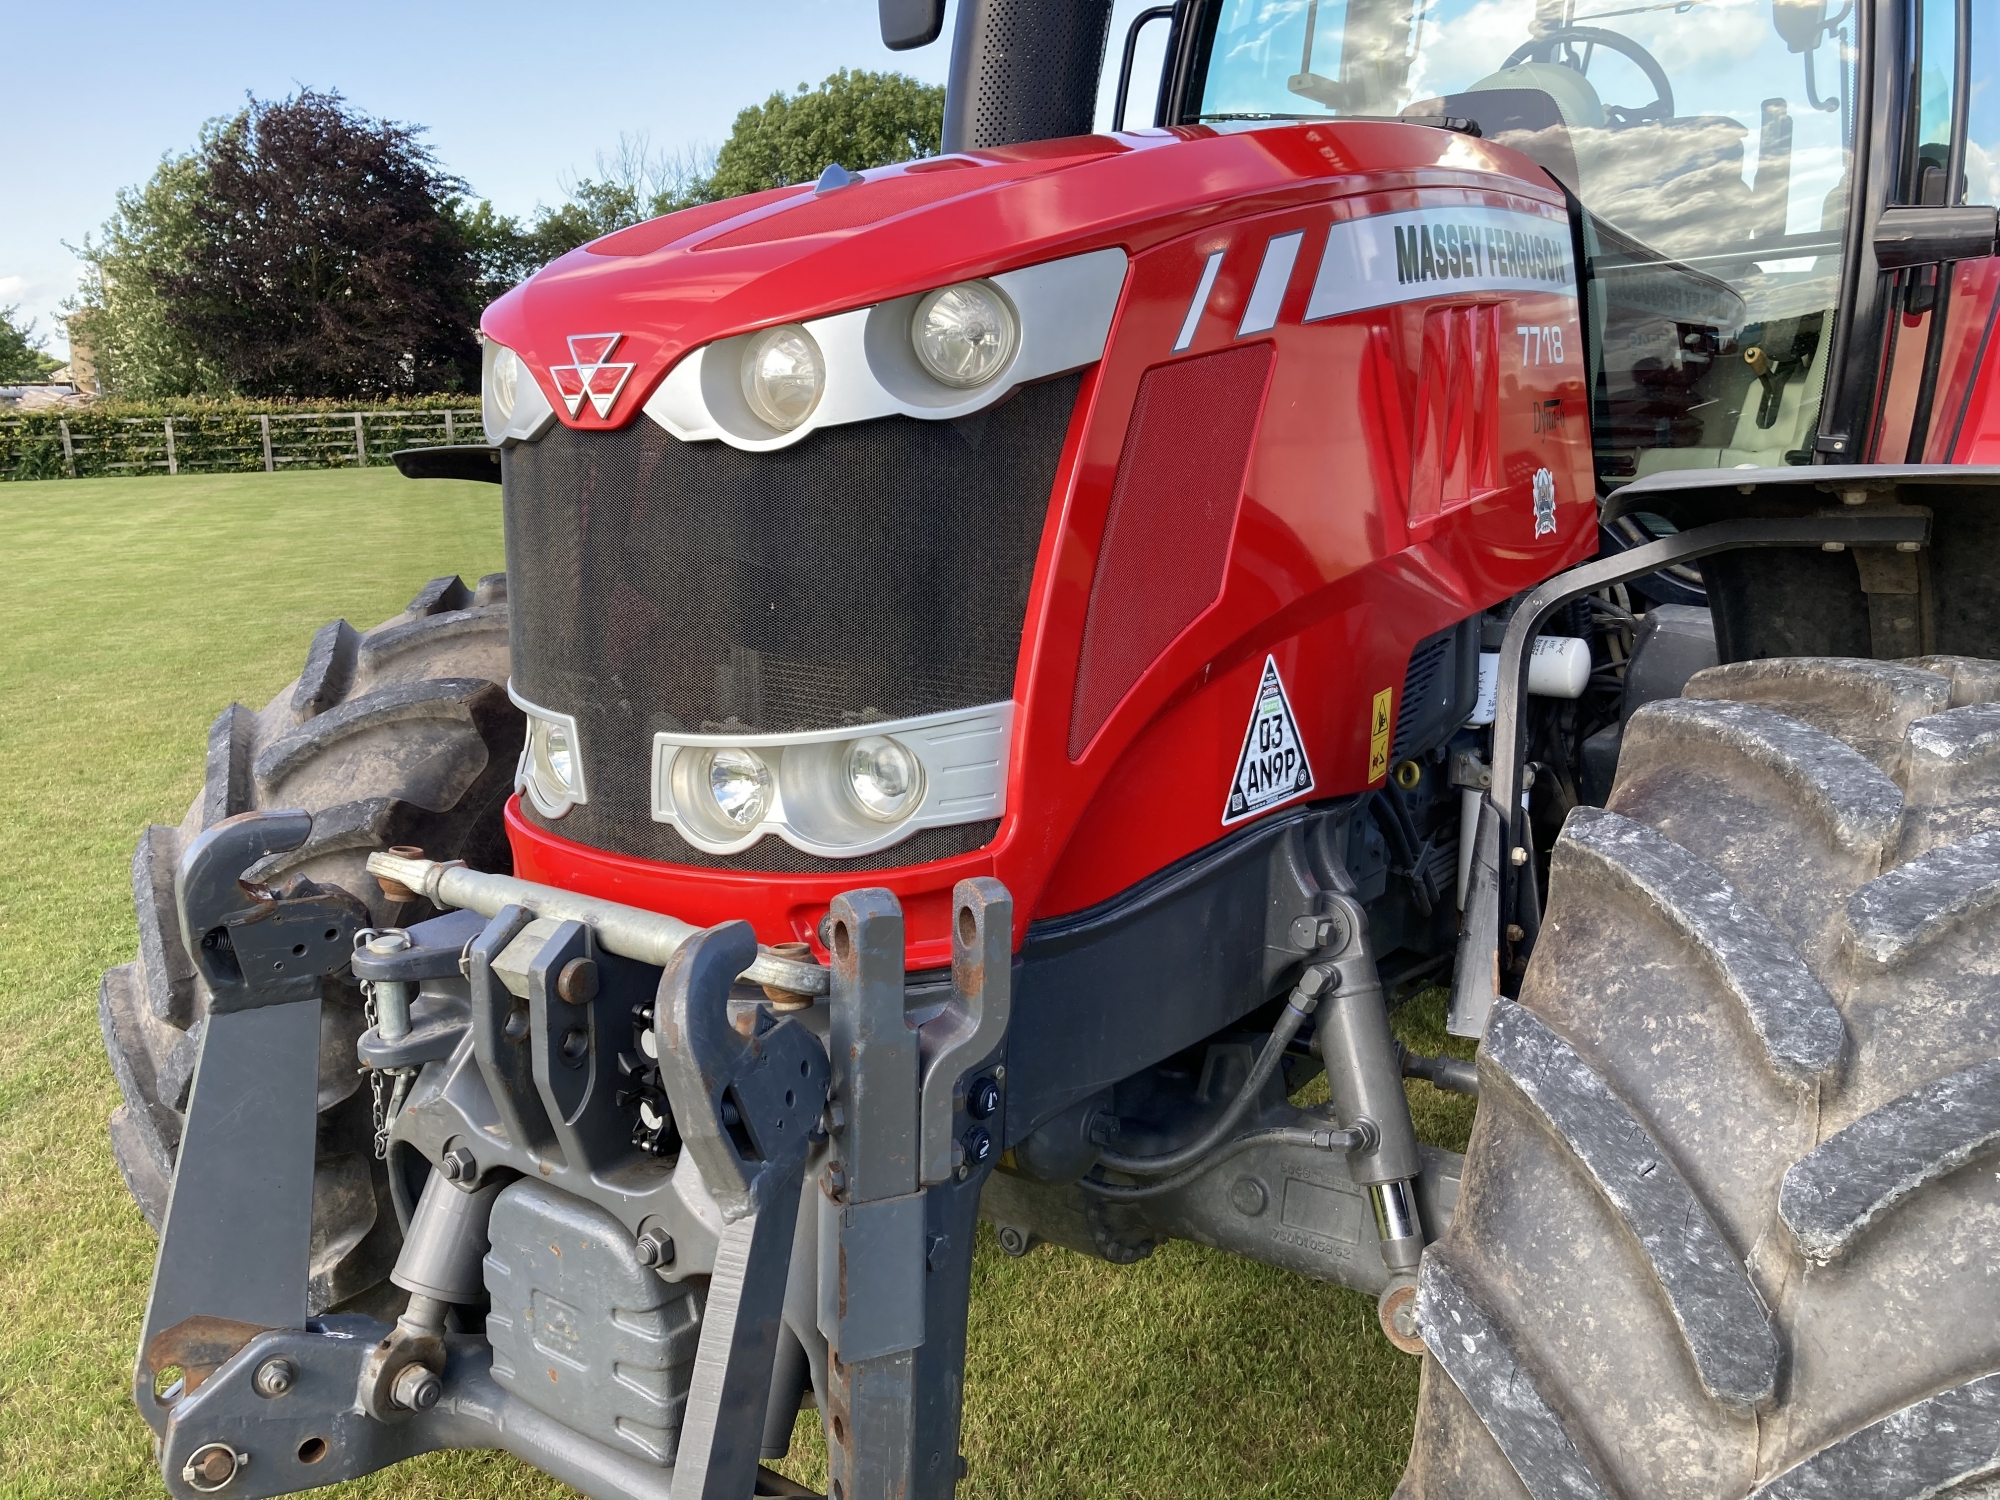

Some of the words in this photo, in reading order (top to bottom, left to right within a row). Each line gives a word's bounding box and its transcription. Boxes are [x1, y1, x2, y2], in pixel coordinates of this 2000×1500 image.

[1394, 224, 1483, 285] MASSEY
[1485, 227, 1567, 284] FERGUSON
[1516, 325, 1564, 367] 7718
[1533, 398, 1565, 444] Dyna-6
[1248, 748, 1296, 794] AN9P
